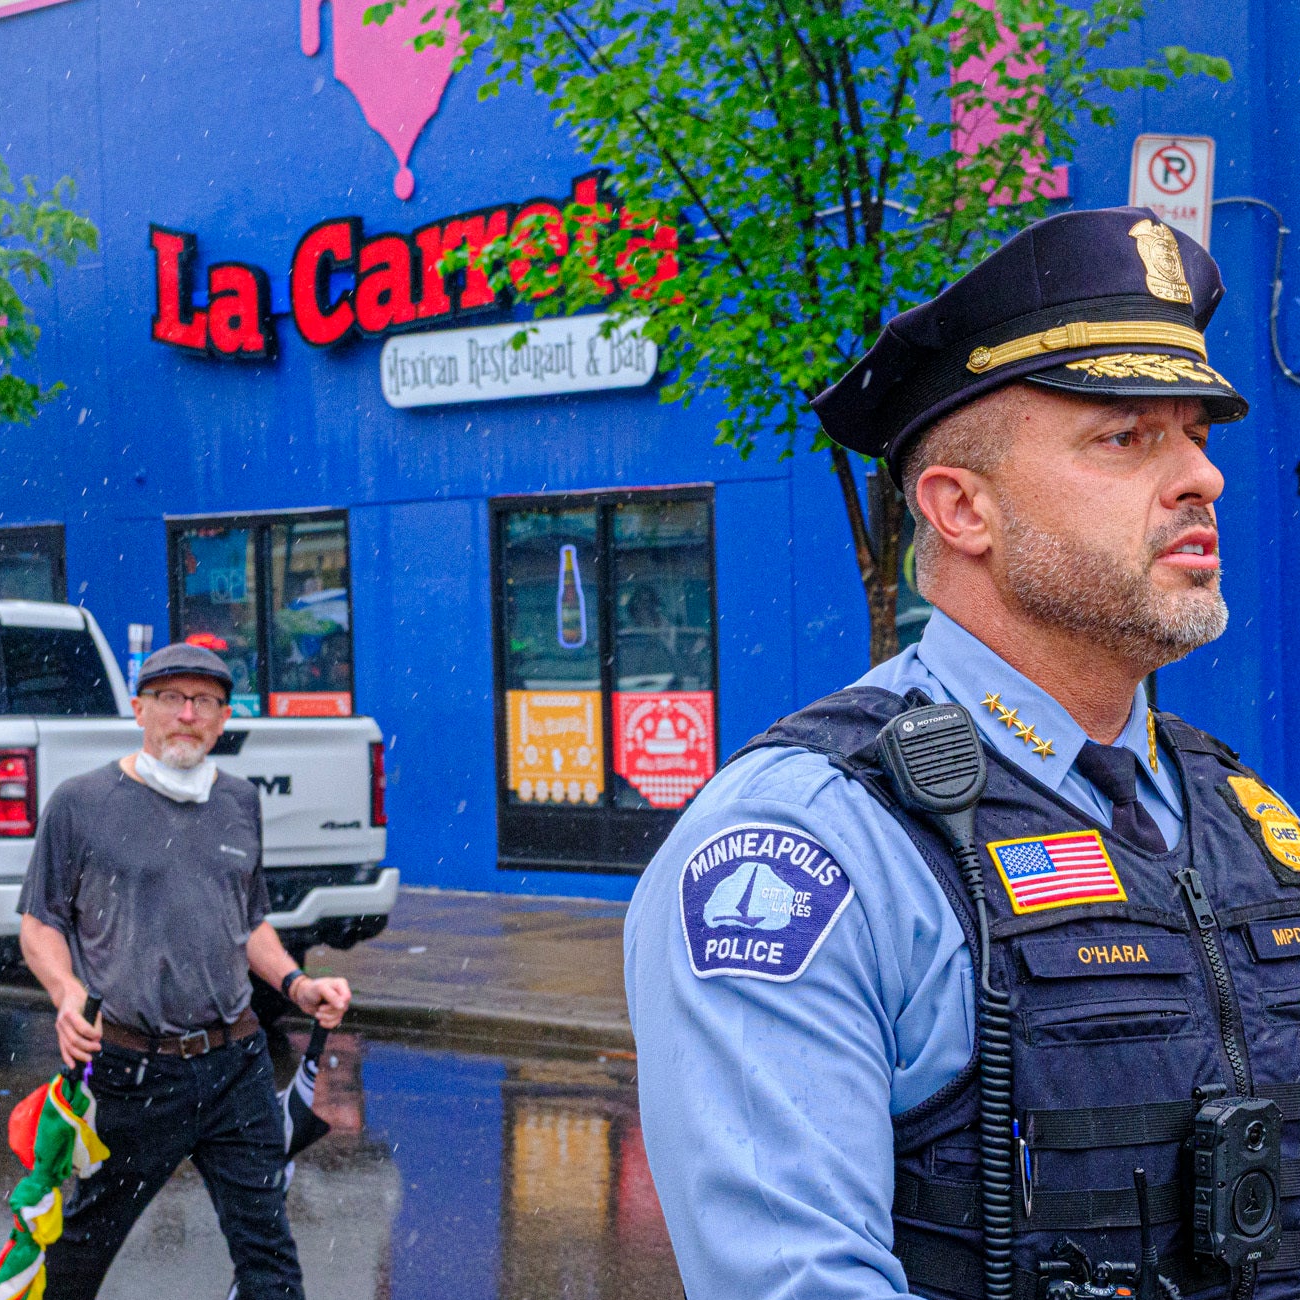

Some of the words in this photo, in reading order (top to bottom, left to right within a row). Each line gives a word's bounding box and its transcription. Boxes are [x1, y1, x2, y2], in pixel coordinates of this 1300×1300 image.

[150, 226, 270, 356] La
[585, 337, 600, 377] &
[916, 713, 958, 727] MOTOROLA
[1271, 827, 1300, 841] CHIEF
[690, 832, 842, 887] MINNEAPOLIS
[761, 888, 788, 900] CITY
[795, 891, 812, 904] OF
[771, 903, 812, 918] LAKES
[705, 938, 784, 965] POLICE
[1078, 944, 1150, 965] O'HARA
